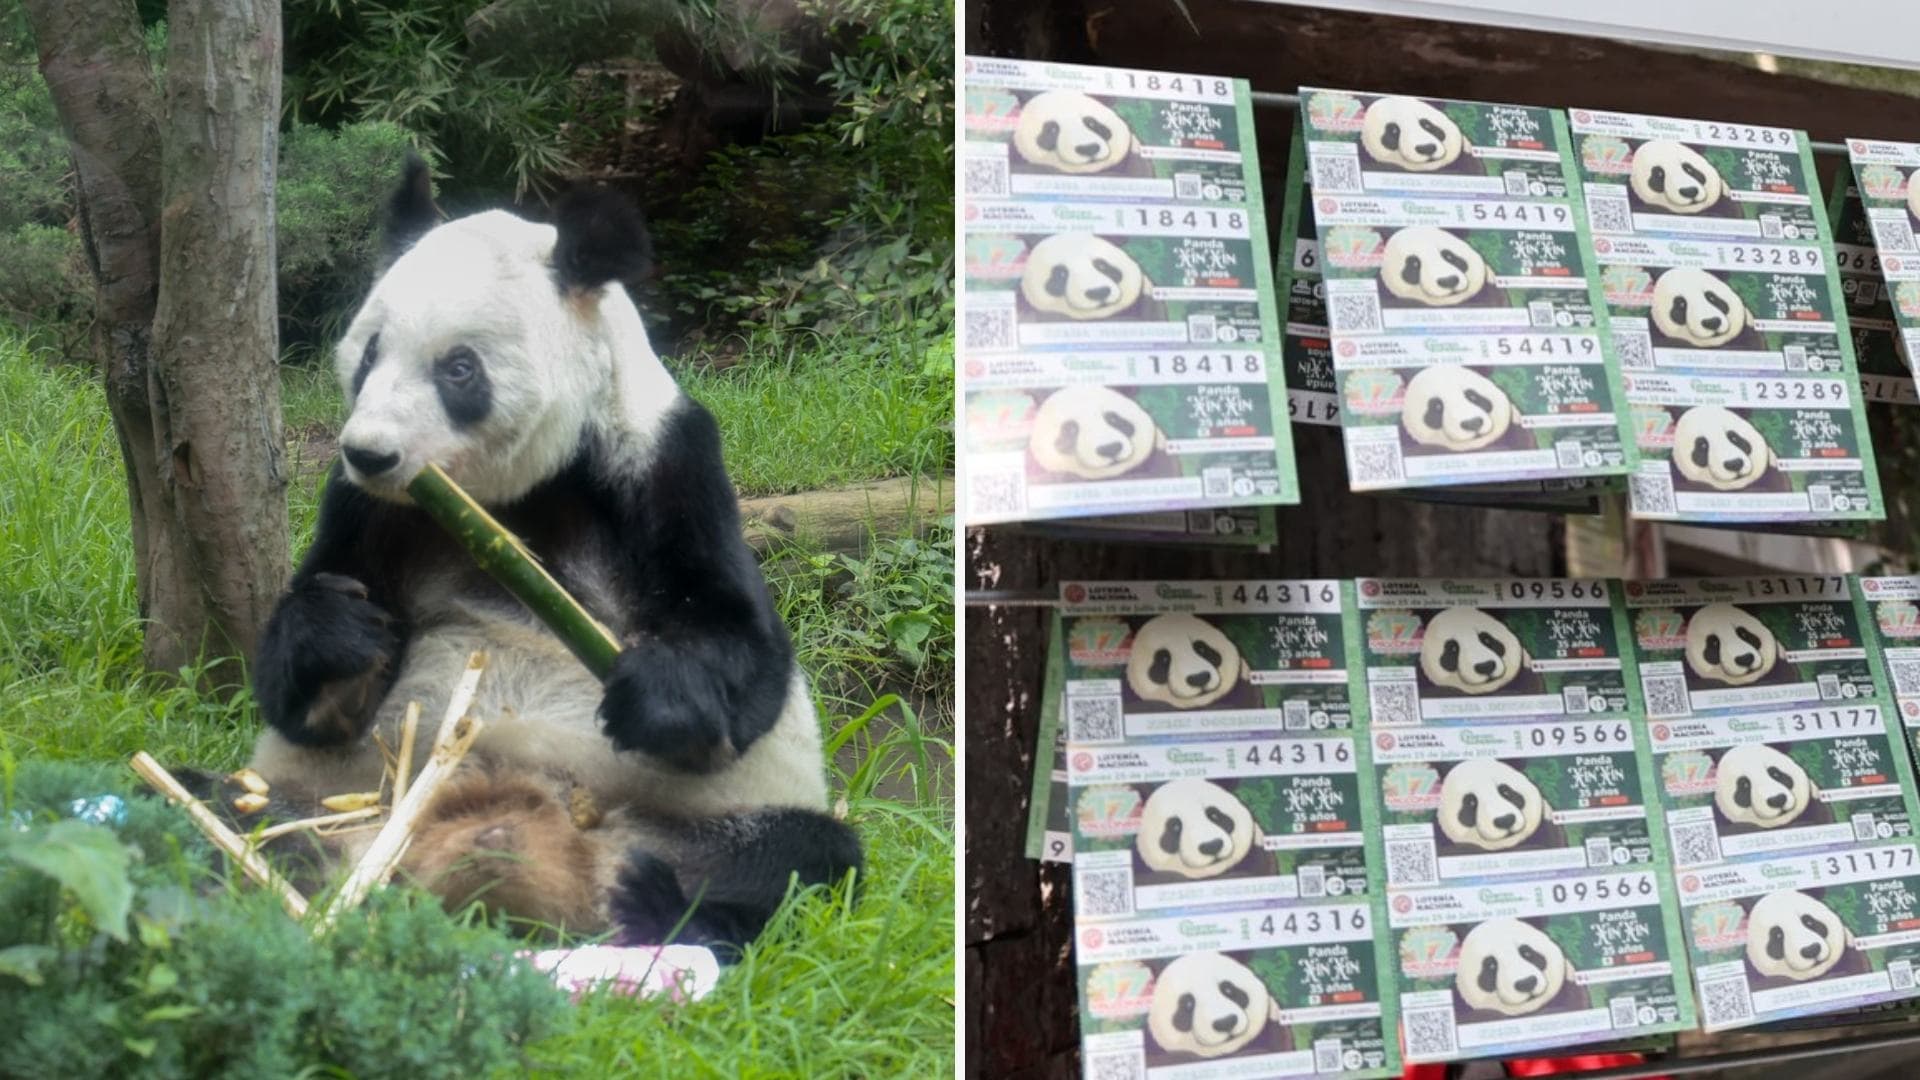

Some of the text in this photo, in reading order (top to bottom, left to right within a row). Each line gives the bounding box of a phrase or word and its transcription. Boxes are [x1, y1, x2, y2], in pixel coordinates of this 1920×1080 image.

[1127, 74, 1227, 96] 18418
[1170, 102, 1209, 111] Panda
[1708, 124, 1790, 144] 23289
[1748, 151, 1779, 159] Panda
[1136, 209, 1242, 229] 18418
[1473, 204, 1565, 222] 54419
[1733, 247, 1817, 265] 23289
[1773, 275, 1805, 283] Panda
[1498, 337, 1593, 354] 54419
[1149, 355, 1259, 373] 18418
[1543, 365, 1580, 374] Panda
[1756, 382, 1842, 399] 23289
[1510, 581, 1602, 599] 09566
[1761, 576, 1842, 593] 31177
[1233, 584, 1333, 603] 44316
[1553, 609, 1588, 617] Panda
[1801, 603, 1832, 611] Panda
[1278, 616, 1316, 625] Panda
[1792, 708, 1876, 730] 31177
[1531, 724, 1626, 746] 09566
[1835, 737, 1867, 747] Panda
[1246, 742, 1348, 764] 44316
[1575, 755, 1612, 765] Panda
[1292, 776, 1331, 787] Panda
[1826, 848, 1912, 874] 31177
[1552, 876, 1651, 902] 09566
[1869, 879, 1903, 891] Panda
[1260, 909, 1364, 934] 44316
[1599, 909, 1636, 921] Panda
[1307, 944, 1347, 957] Panda
